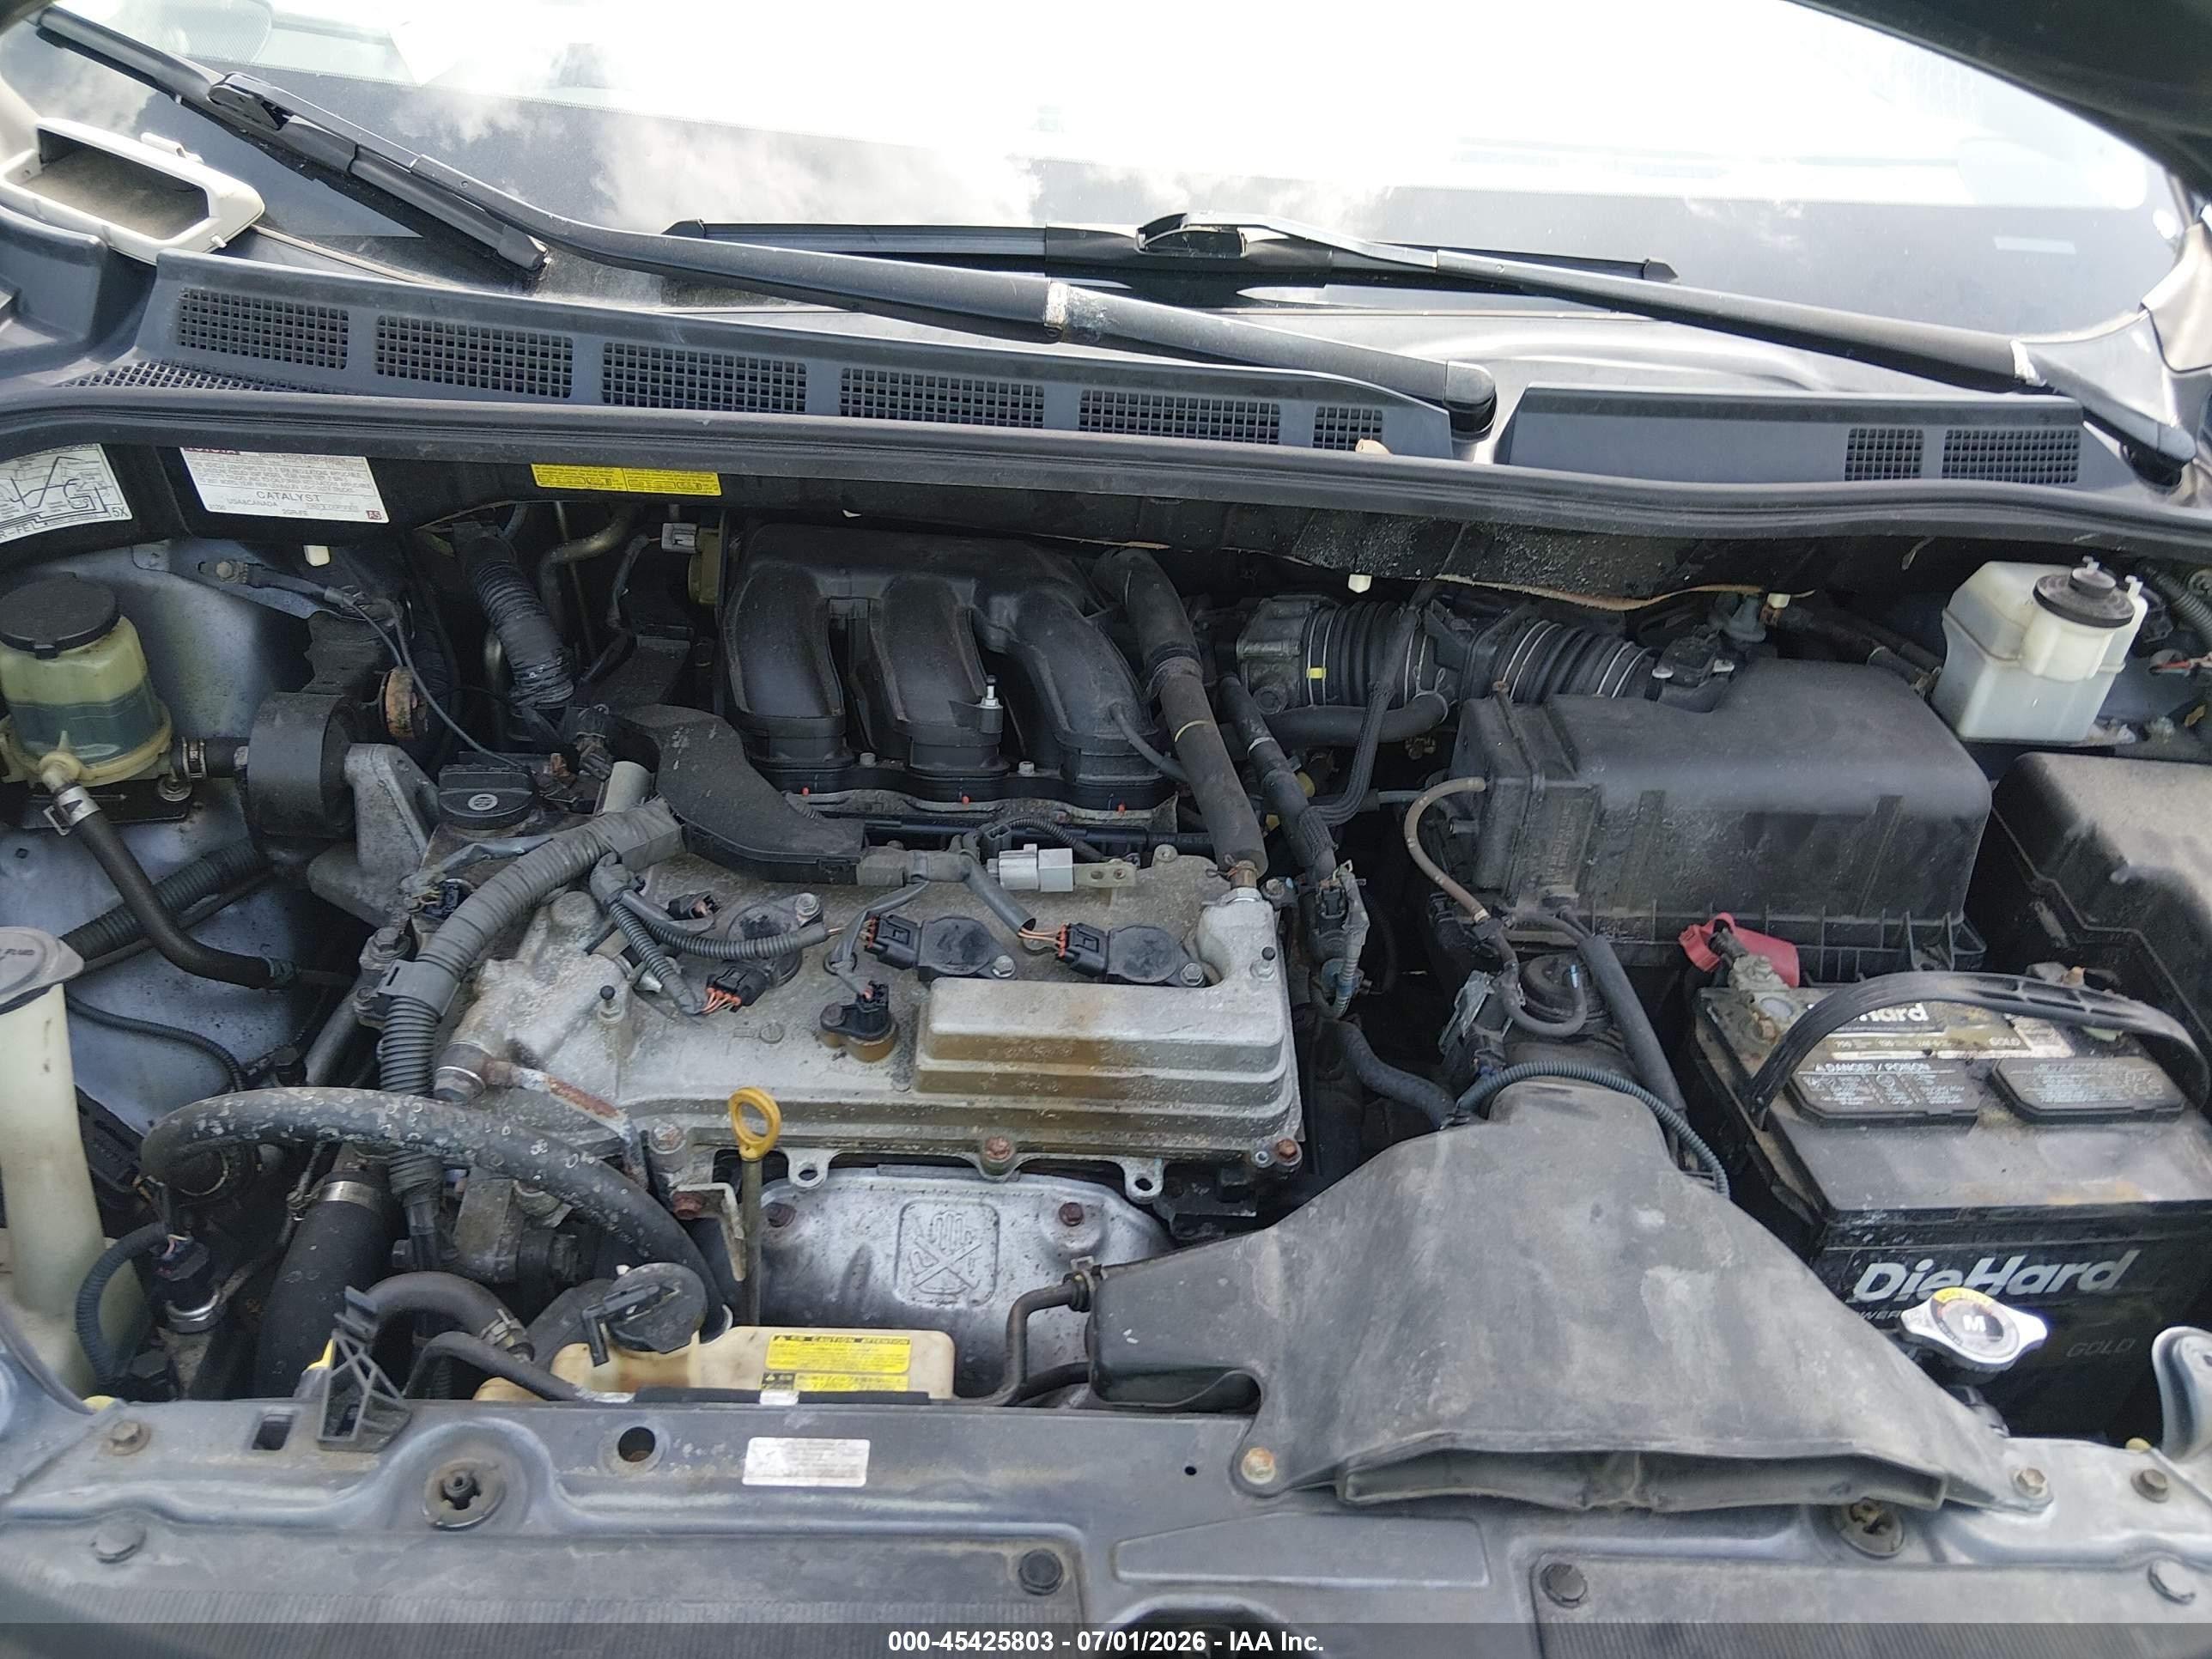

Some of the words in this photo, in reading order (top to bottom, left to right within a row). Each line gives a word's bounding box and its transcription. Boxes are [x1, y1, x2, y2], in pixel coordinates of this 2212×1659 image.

[256, 490, 321, 502] CATALYST
[112, 507, 128, 518] 5X
[1852, 1250, 2140, 1302] DieHard
[2066, 1339, 2136, 1358] GOLD
